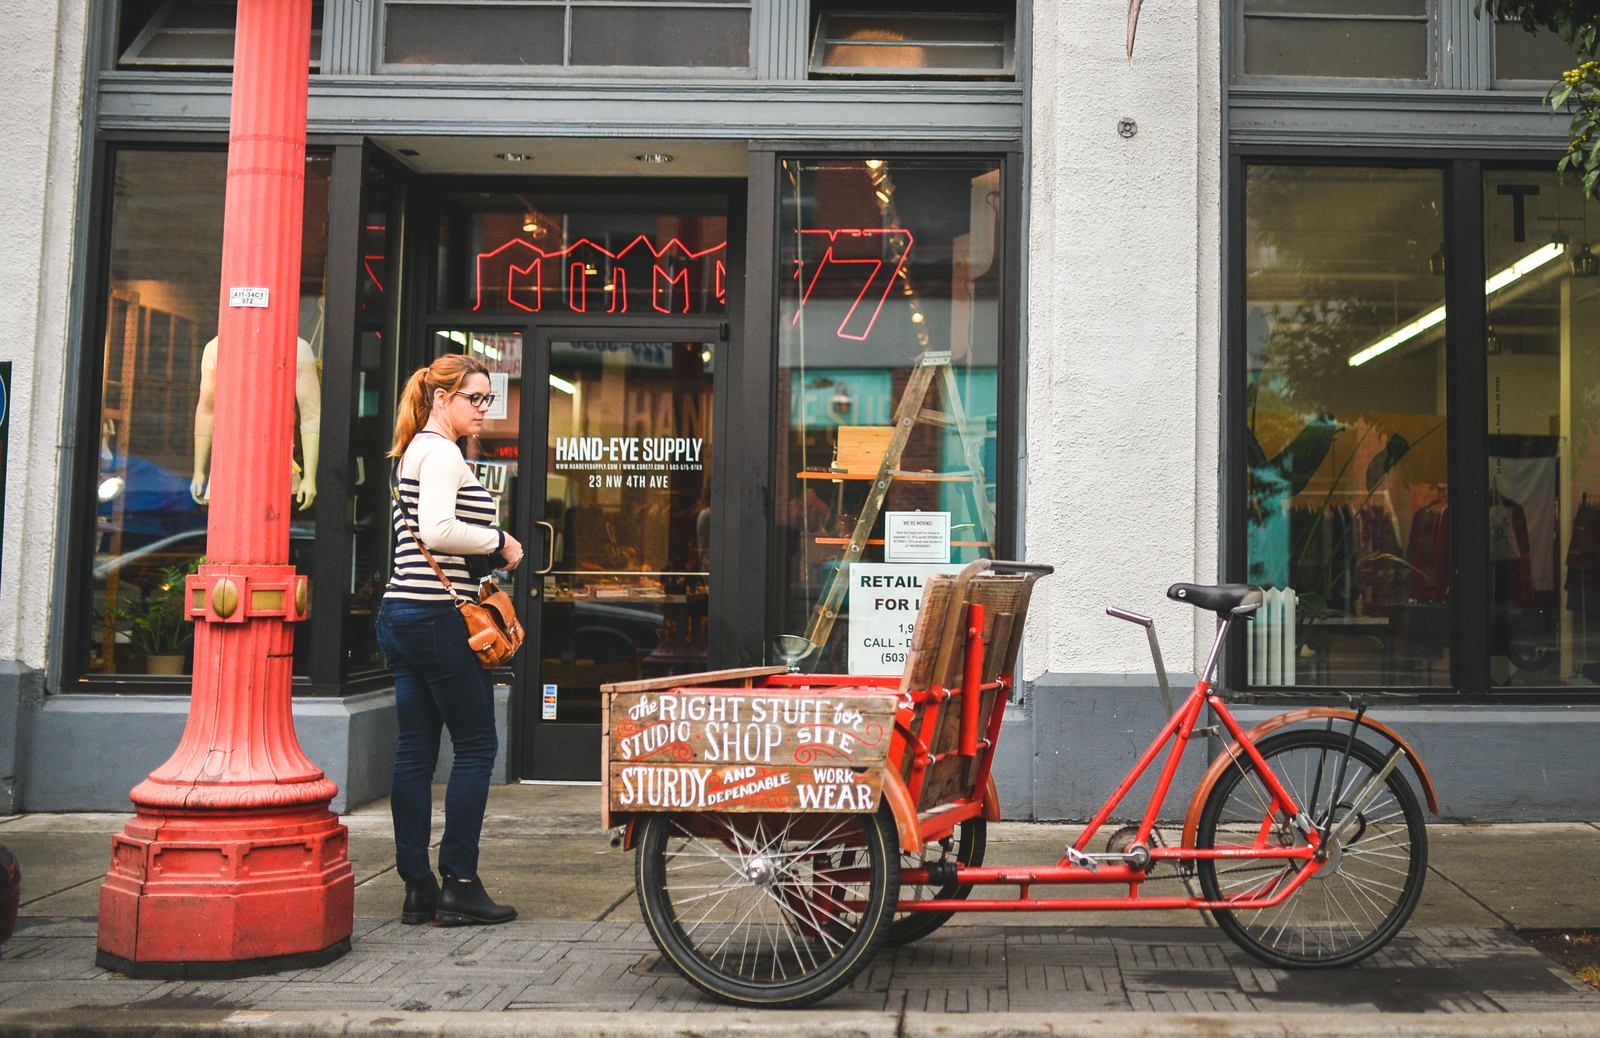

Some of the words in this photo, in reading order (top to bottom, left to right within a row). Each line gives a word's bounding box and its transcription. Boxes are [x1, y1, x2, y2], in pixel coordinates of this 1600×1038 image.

[555, 437, 639, 462] HAND-EYE
[643, 437, 703, 462] SUPPLY
[588, 475, 602, 488] 23
[606, 475, 622, 488] NW
[626, 475, 646, 488] 4TH
[649, 475, 668, 489] AVE
[860, 575, 923, 588] RETAIL
[874, 598, 909, 611] FOR
[863, 637, 895, 648] CALL
[628, 694, 659, 721] The
[659, 695, 746, 723] RIGHT
[751, 697, 831, 725] STUFF
[620, 720, 691, 760] STUDIO
[704, 721, 782, 762] SHOP
[796, 725, 855, 755] SITE
[723, 765, 756, 785] AND
[812, 766, 855, 784] WORK
[620, 765, 713, 808] STURDY
[707, 772, 791, 806] DEPENDABLE
[796, 783, 874, 811] WEAR
